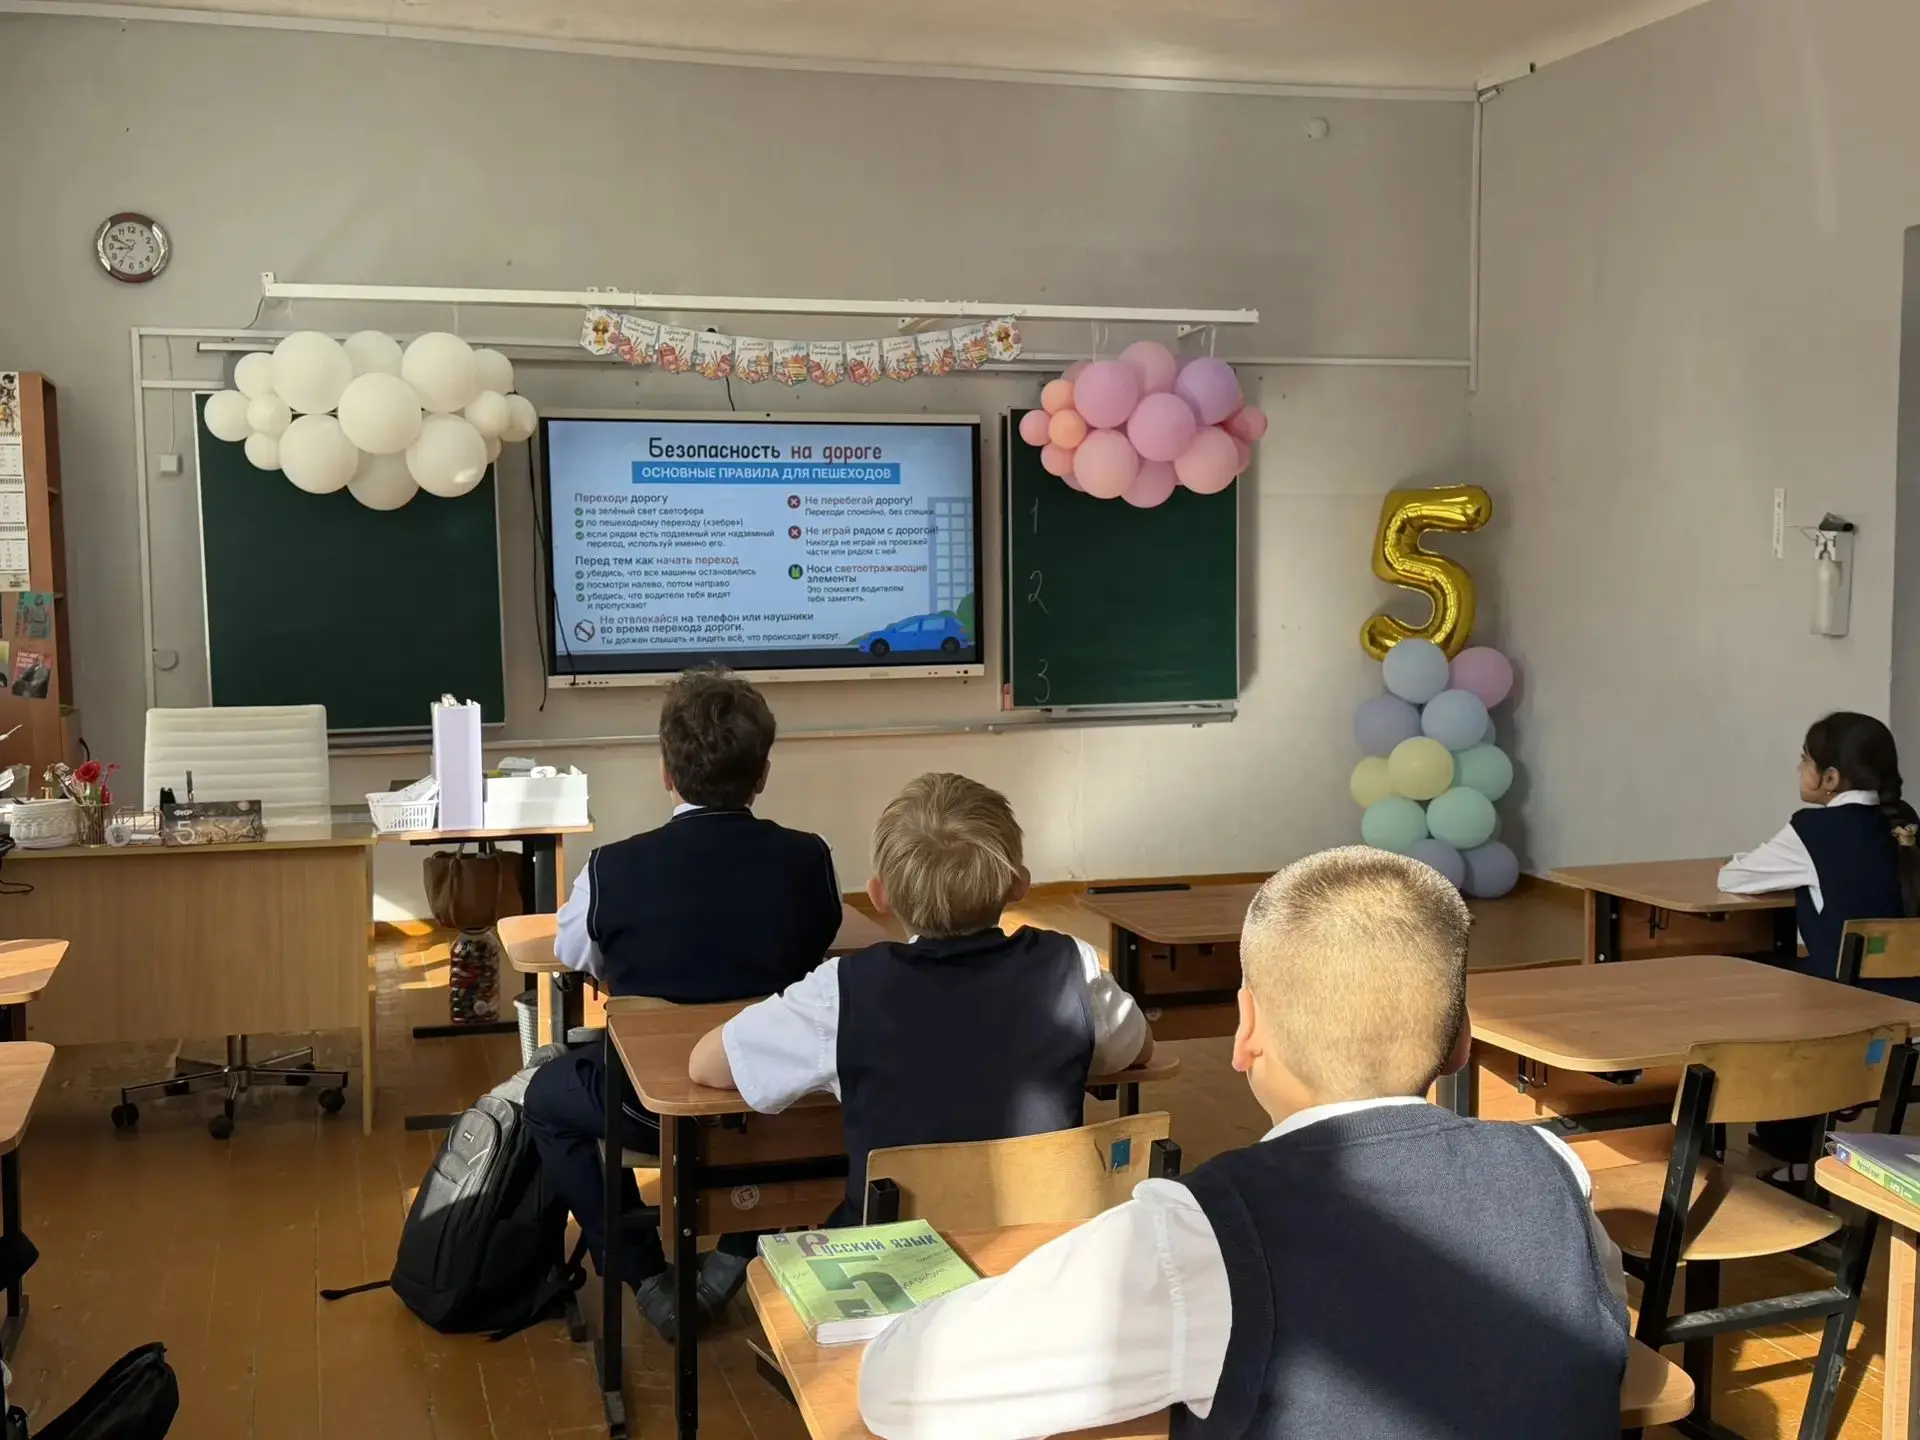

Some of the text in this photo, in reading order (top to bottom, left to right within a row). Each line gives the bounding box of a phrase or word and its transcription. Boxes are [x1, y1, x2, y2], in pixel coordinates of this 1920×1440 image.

[649, 437, 882, 465] Безопасность на дороге
[642, 467, 891, 480] ОСНОВНЫЕ ПРАВИЛА ДЛЯ ПЕШЕХОДОВ
[574, 493, 668, 504] Переходи дорогу
[821, 496, 873, 506] перебегай
[876, 496, 912, 506] дорогу!
[659, 508, 704, 516] светофора
[1030, 498, 1038, 533] 1
[600, 520, 659, 528] пешеходному
[661, 519, 700, 527] переходу
[704, 519, 743, 527] («зебре»)
[610, 531, 637, 539] рядом
[661, 530, 709, 538] подземный
[728, 530, 774, 538] надземный
[806, 527, 819, 535] Не
[822, 526, 850, 536] играй
[853, 526, 884, 536] рядом
[896, 526, 938, 535] дорогой!
[587, 541, 625, 549] переход,
[628, 540, 672, 548] используй
[709, 540, 725, 548] его.
[889, 538, 927, 546] проезжей
[575, 556, 610, 566] Перед
[695, 557, 739, 566] переход
[699, 568, 756, 576] остановились
[807, 564, 927, 573] Носи светоотражающие
[1360, 485, 1492, 661] 5
[695, 580, 729, 588] направо
[587, 593, 625, 601] убедись,
[645, 592, 684, 600] водители
[707, 591, 730, 599] видят
[1028, 570, 1049, 615] 2
[595, 602, 647, 611] пропускают
[600, 613, 814, 624] Не отвлекайся на телефон или наушники
[601, 624, 744, 635] во время перехода дороги.
[615, 636, 648, 646] должен
[650, 635, 687, 644] слышать
[728, 634, 744, 644] всё,
[763, 634, 809, 643] происходит
[812, 633, 840, 641] вокруг.
[1034, 659, 1050, 703] 3
[797, 1233, 938, 1257] Русский язык
